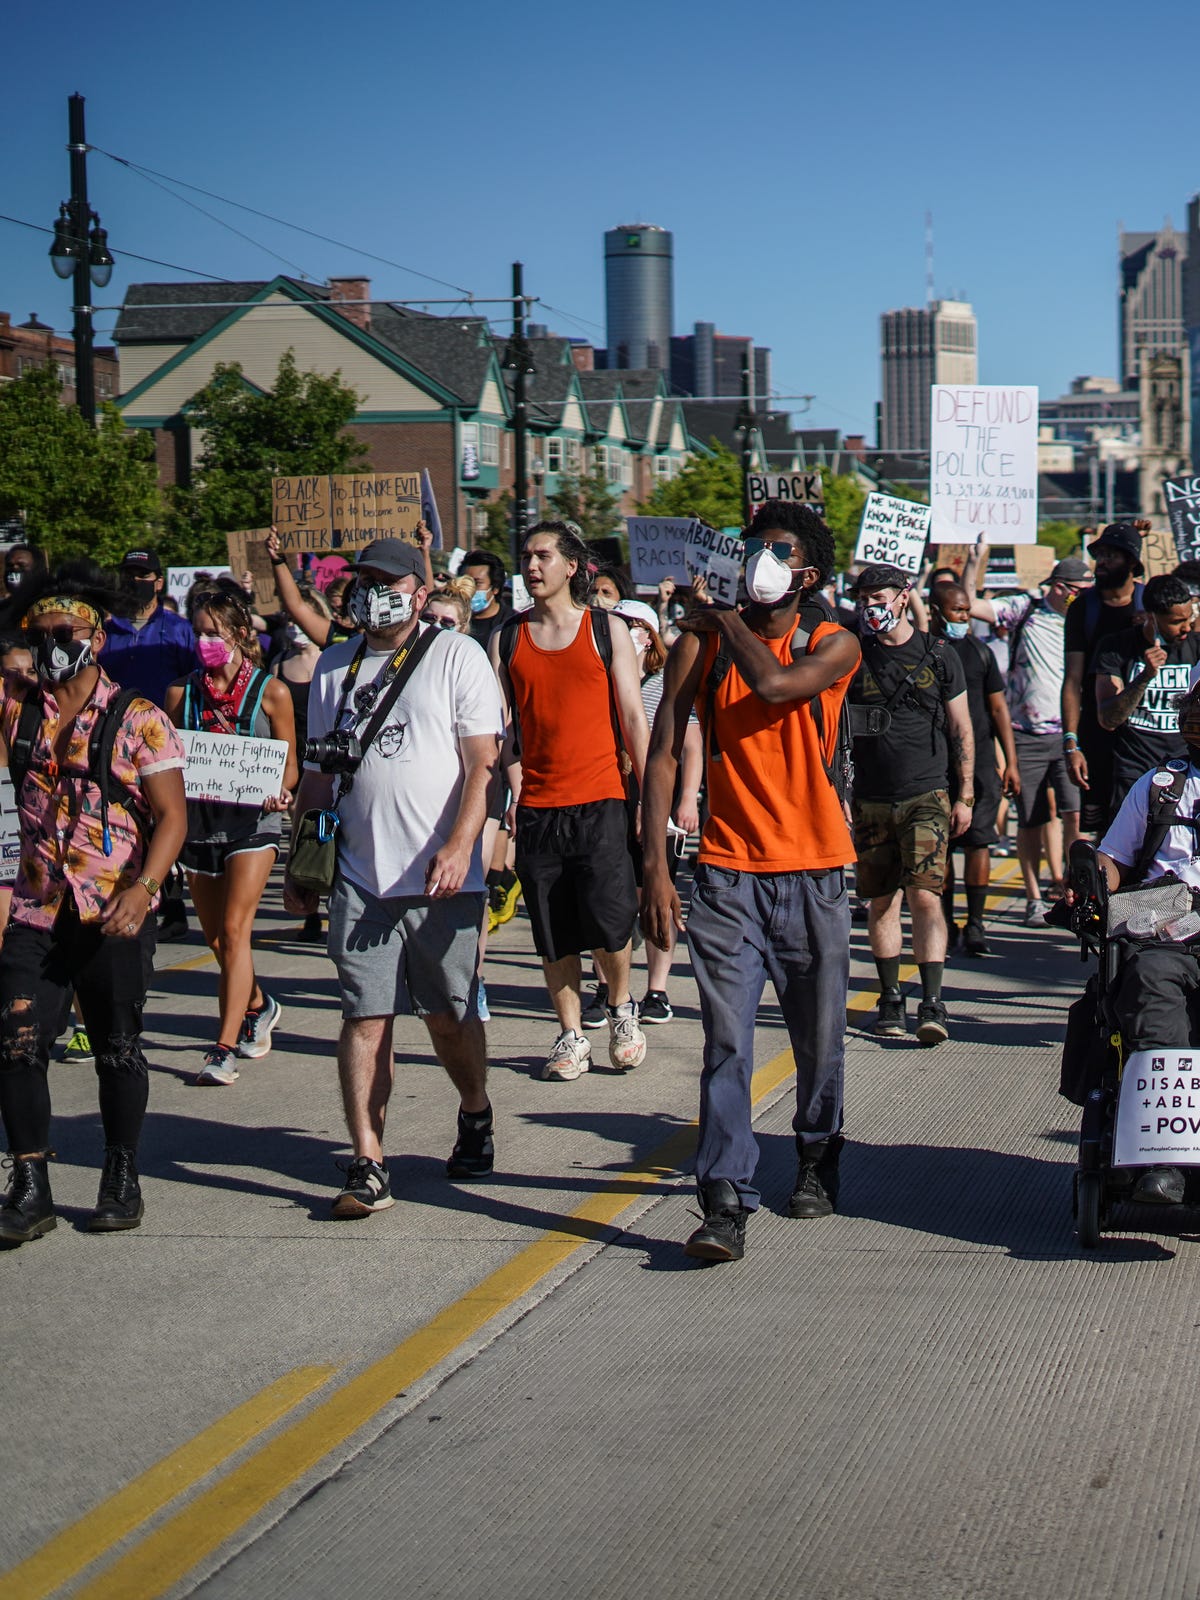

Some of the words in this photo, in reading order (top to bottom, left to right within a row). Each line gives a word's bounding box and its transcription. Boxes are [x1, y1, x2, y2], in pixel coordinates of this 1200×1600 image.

[937, 389, 1033, 424] DEFUND
[956, 425, 1001, 452] THE
[935, 451, 1016, 477] POLICE
[275, 478, 321, 501] BLACK
[348, 479, 393, 499] IGNORE
[394, 477, 420, 497] EVIL
[749, 475, 819, 502] BLACK
[274, 502, 325, 524] LIVES
[871, 496, 884, 506] WE
[888, 500, 908, 513] WILL
[910, 505, 929, 516] NOT
[954, 499, 998, 525] FUCK
[867, 509, 894, 523] KNOW
[896, 513, 926, 531] PEACE
[277, 527, 330, 549] MATTER
[635, 524, 659, 541] NO
[685, 522, 744, 562] ABOLISH
[877, 537, 899, 551] NO
[637, 547, 685, 567] RACIS
[863, 544, 917, 570] POLICE
[169, 573, 191, 588] NO
[392, 648, 408, 669] Nikon
[188, 735, 207, 755] I'm
[242, 741, 286, 766] Fighting
[185, 754, 212, 769] gainst
[219, 758, 236, 769] the
[238, 759, 281, 779] System,
[206, 778, 224, 791] the
[228, 780, 264, 802] System
